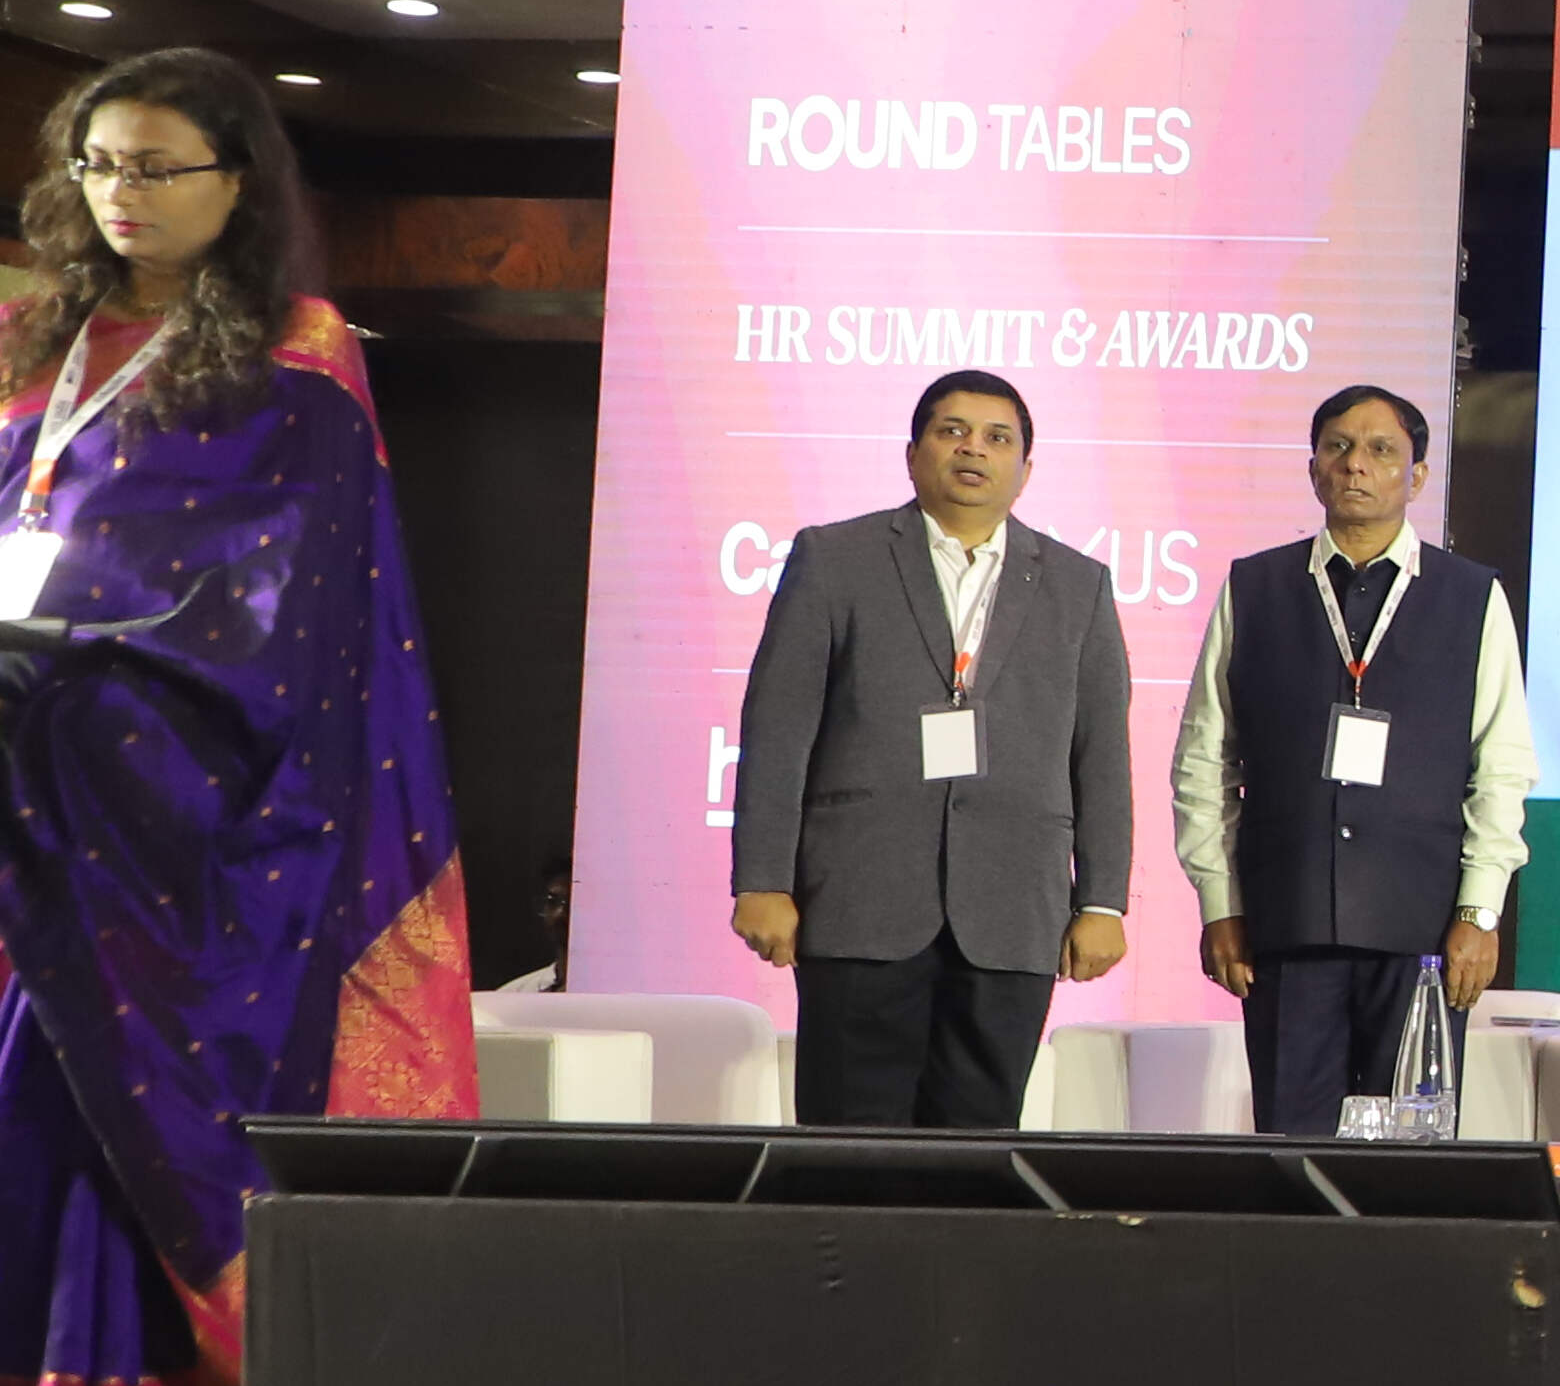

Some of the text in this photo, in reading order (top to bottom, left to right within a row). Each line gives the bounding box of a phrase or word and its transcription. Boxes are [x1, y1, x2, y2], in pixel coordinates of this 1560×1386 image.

[748, 95, 1191, 175] ROUND TABLES
[734, 304, 1313, 373] HR SUMMIT & AWARDS
